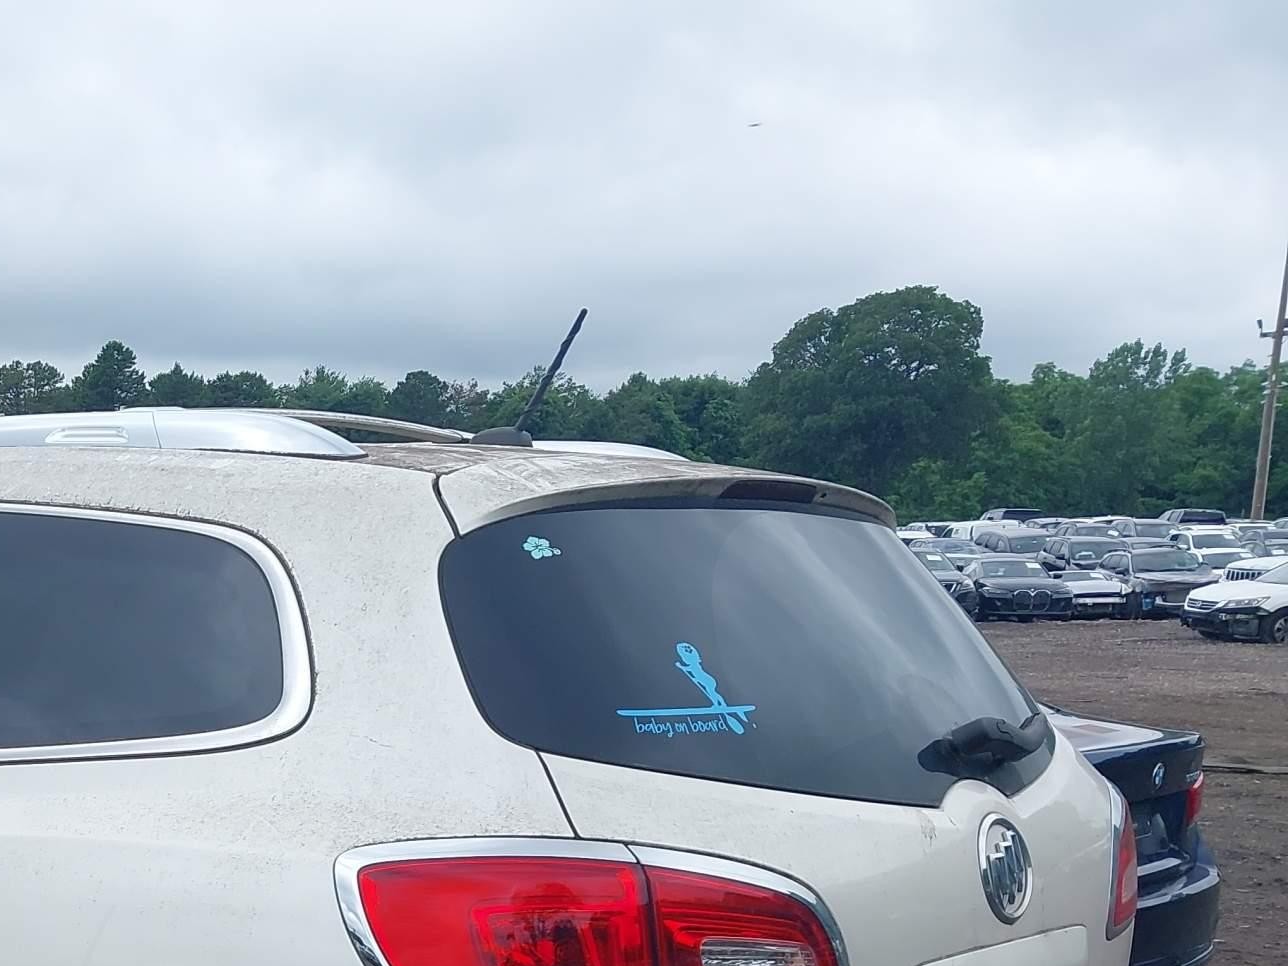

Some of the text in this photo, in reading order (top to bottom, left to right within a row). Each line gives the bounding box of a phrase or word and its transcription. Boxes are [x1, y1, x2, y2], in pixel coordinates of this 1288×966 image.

[634, 714, 728, 738] baby on board
